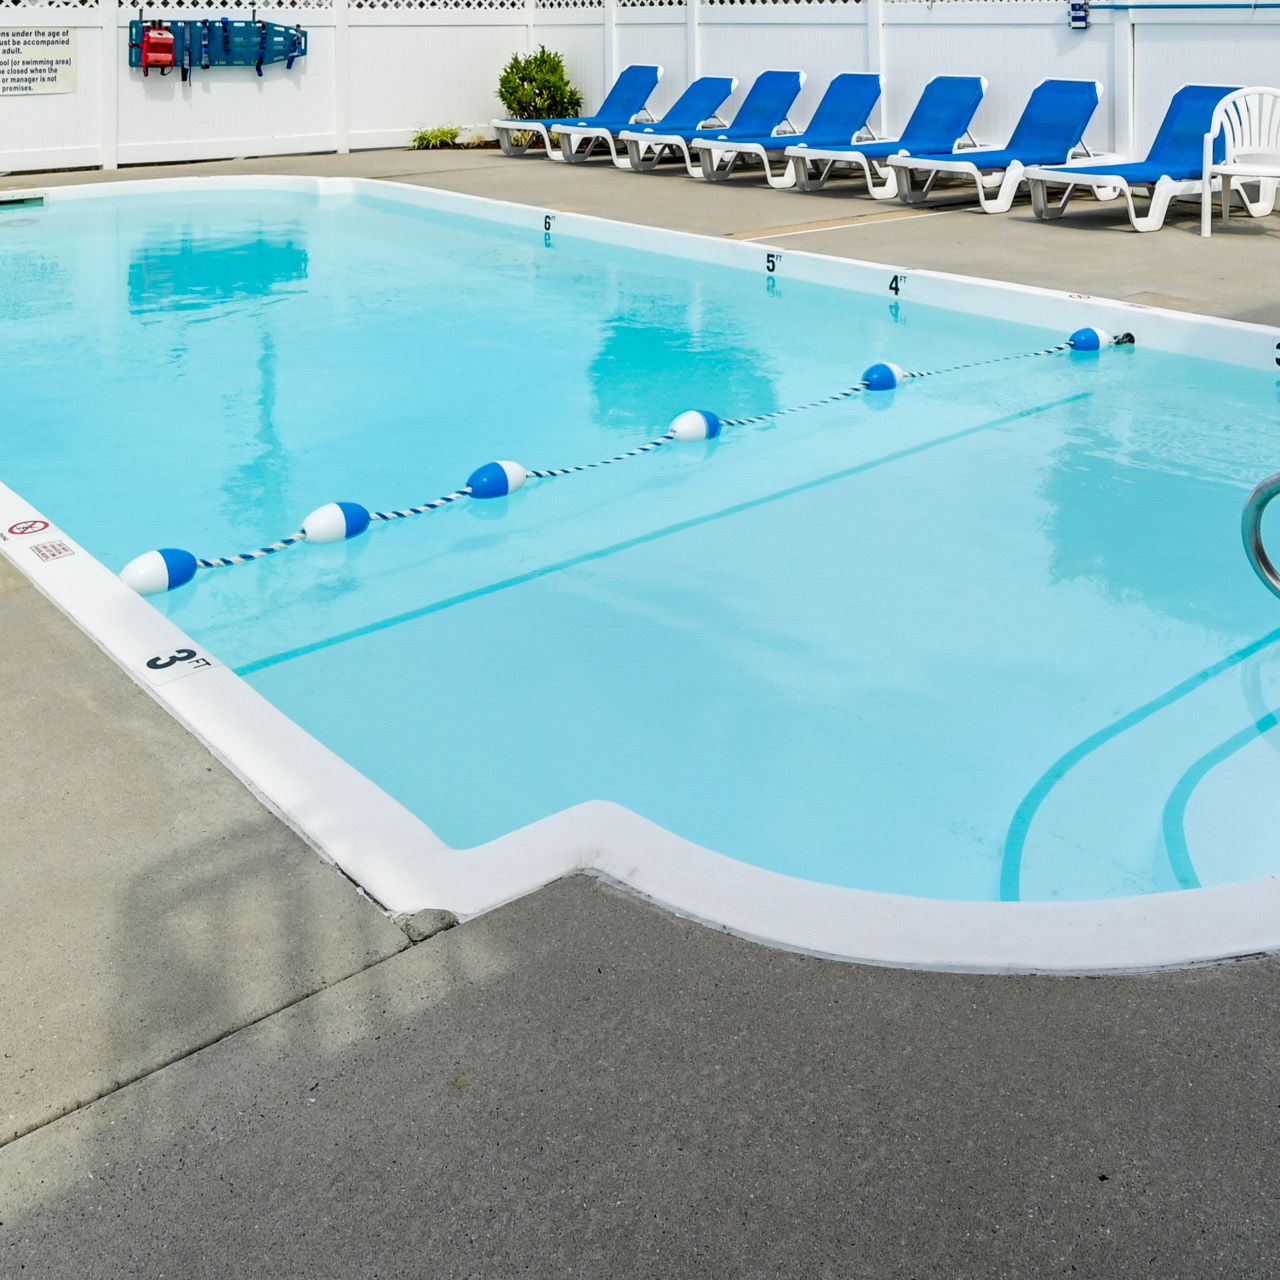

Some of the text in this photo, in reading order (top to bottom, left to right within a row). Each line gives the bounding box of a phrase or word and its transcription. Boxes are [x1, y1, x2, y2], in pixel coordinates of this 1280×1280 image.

[23, 38, 70, 46] accompanied
[21, 58, 54, 66] swimming
[55, 58, 71, 66] area)
[10, 76, 38, 84] manager
[2, 85, 34, 93] premises.
[544, 215, 551, 231] 6
[766, 253, 783, 273] 5 FT
[888, 275, 907, 296] 4 FT
[146, 648, 212, 670] 3 FT
